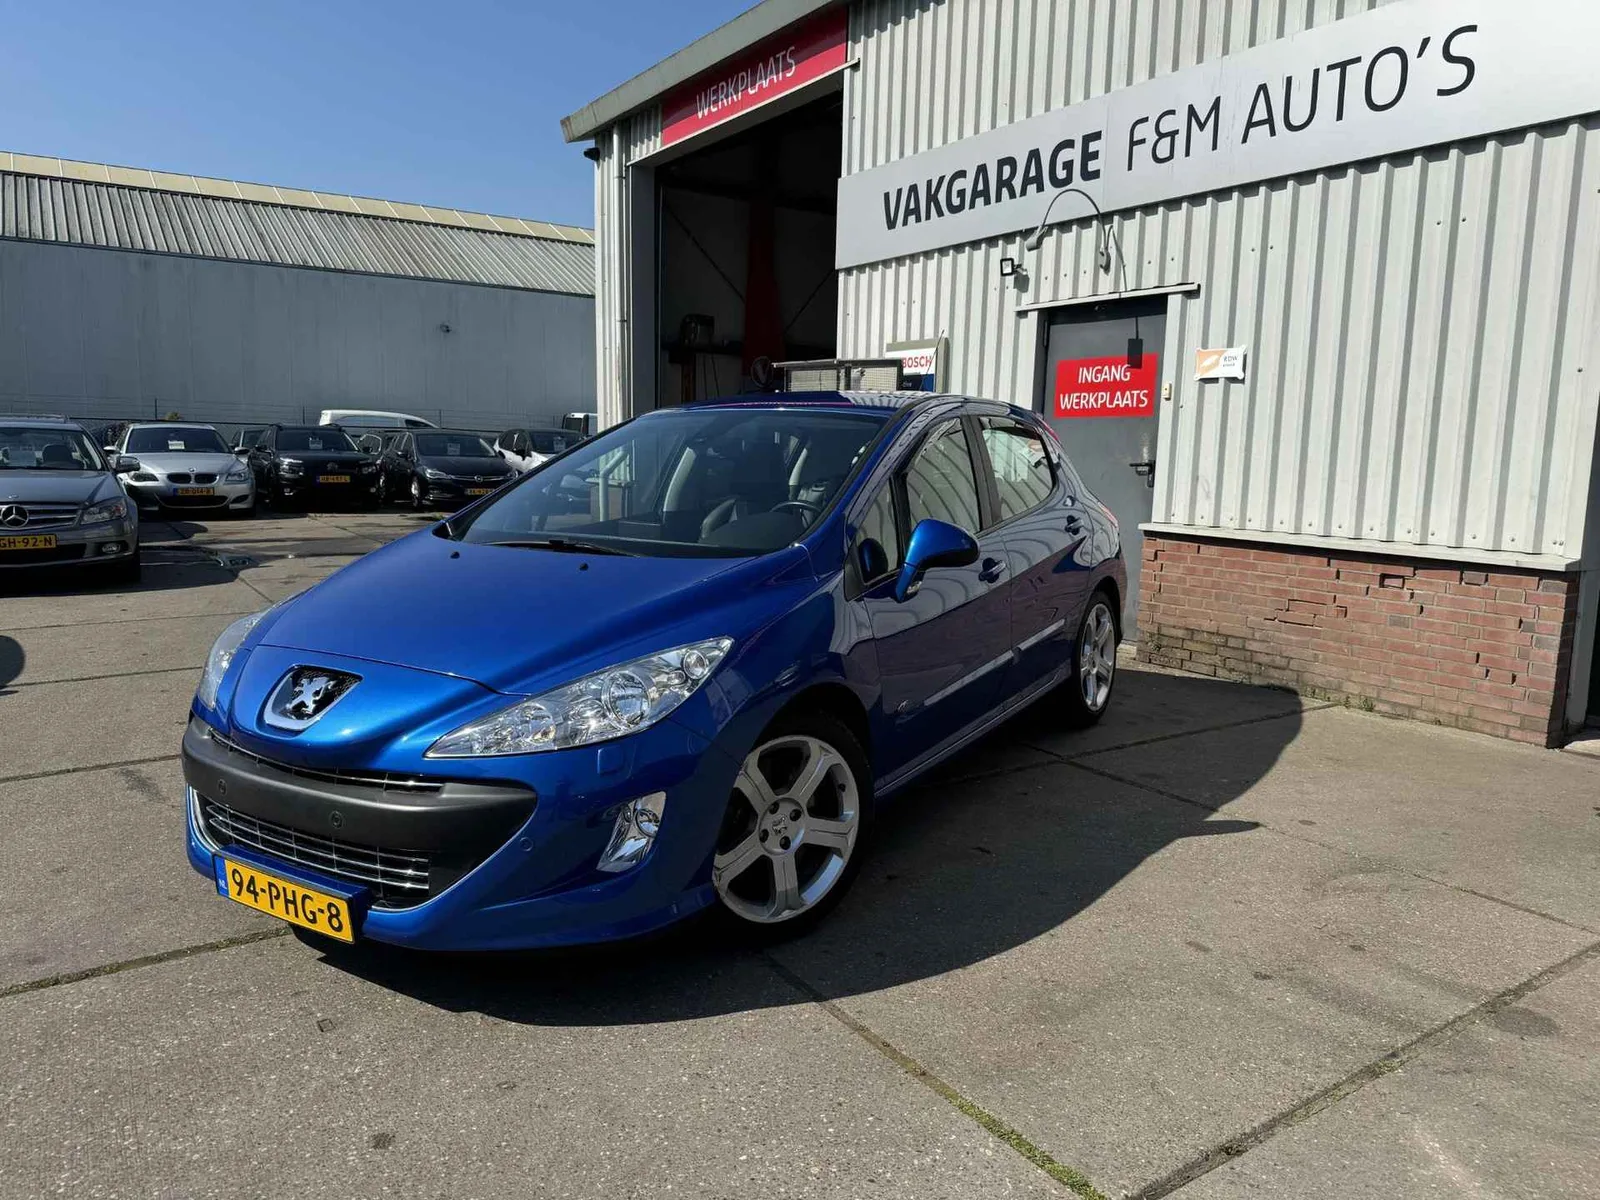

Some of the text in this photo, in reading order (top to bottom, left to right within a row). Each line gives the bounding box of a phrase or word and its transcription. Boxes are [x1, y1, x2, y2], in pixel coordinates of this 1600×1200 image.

[696, 46, 797, 119] WERKPLAATS
[883, 24, 1478, 231] VAKGARAGE F&M AUTO'S
[902, 354, 932, 369] BOSCH
[1078, 364, 1131, 384] INGANG
[1060, 390, 1148, 410] WERKPLAATS
[218, 878, 228, 890] NL
[231, 867, 343, 933] 94-PHG-8
